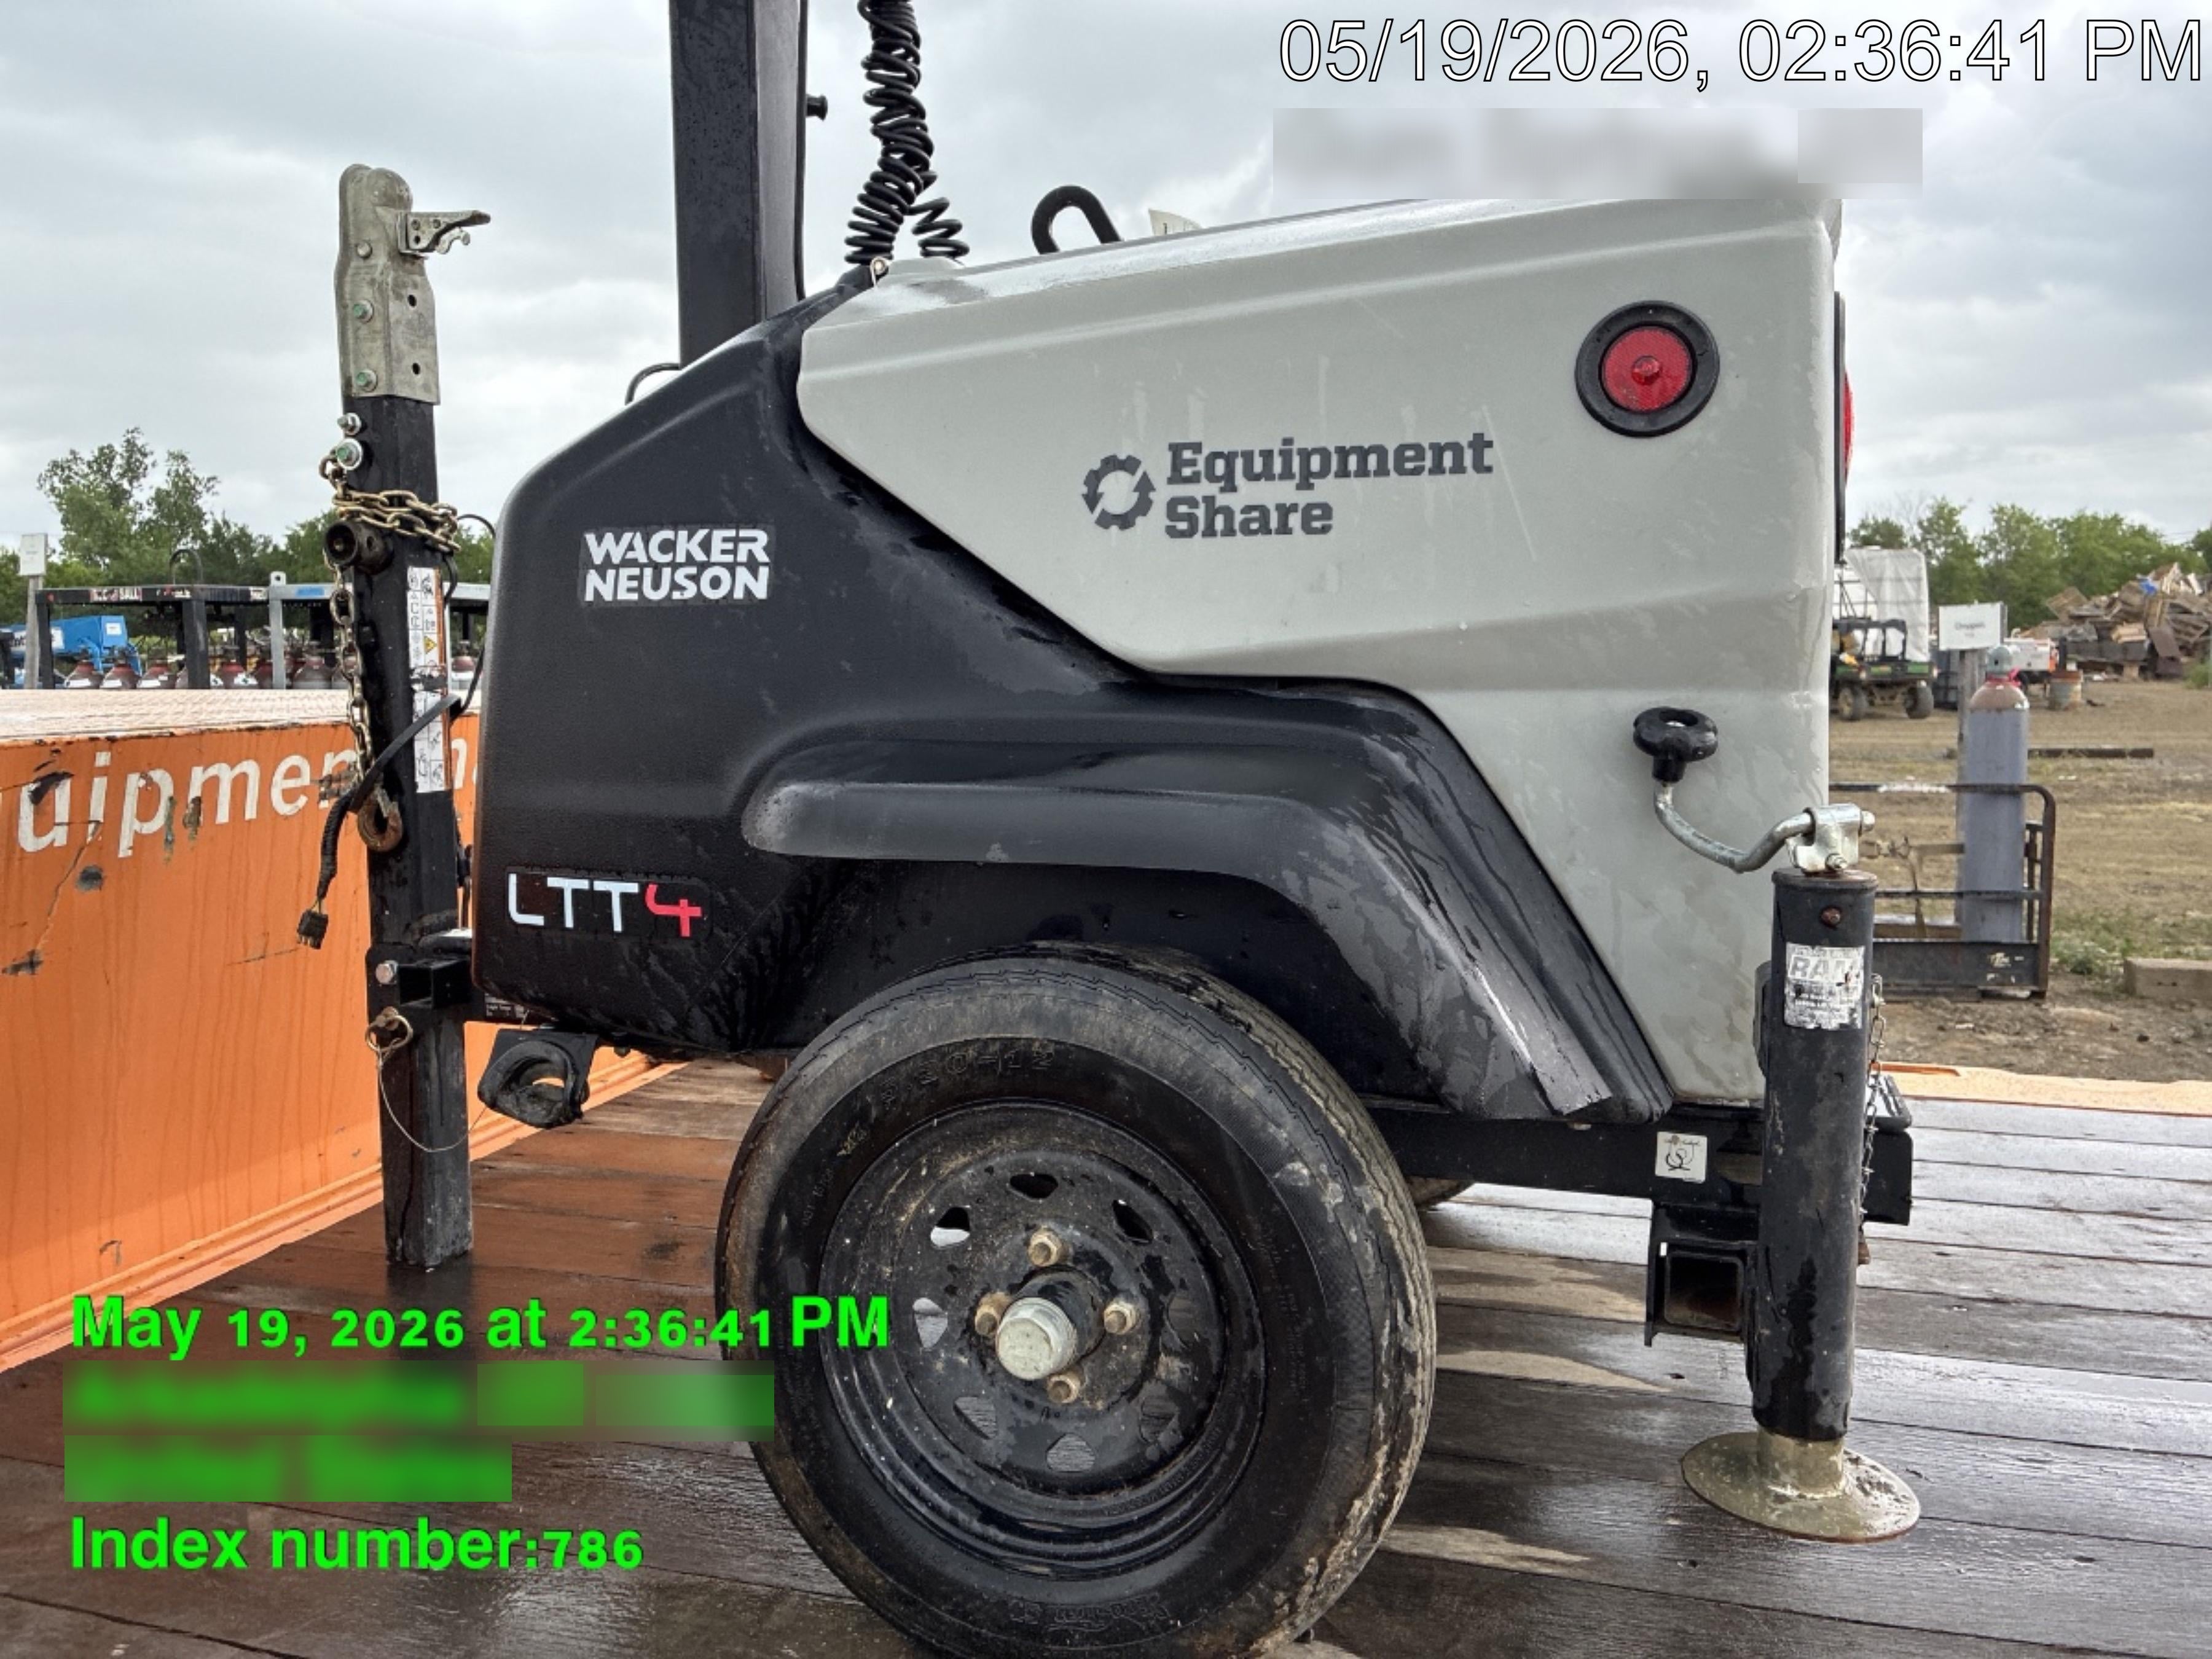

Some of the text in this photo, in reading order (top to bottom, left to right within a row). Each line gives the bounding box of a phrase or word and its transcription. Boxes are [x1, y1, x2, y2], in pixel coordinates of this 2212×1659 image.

[1166, 432, 1494, 493] Equipment
[1164, 495, 1333, 539] Share
[584, 528, 771, 565] WACKER
[584, 565, 771, 602] NEUSON
[508, 873, 702, 938] LTT4
